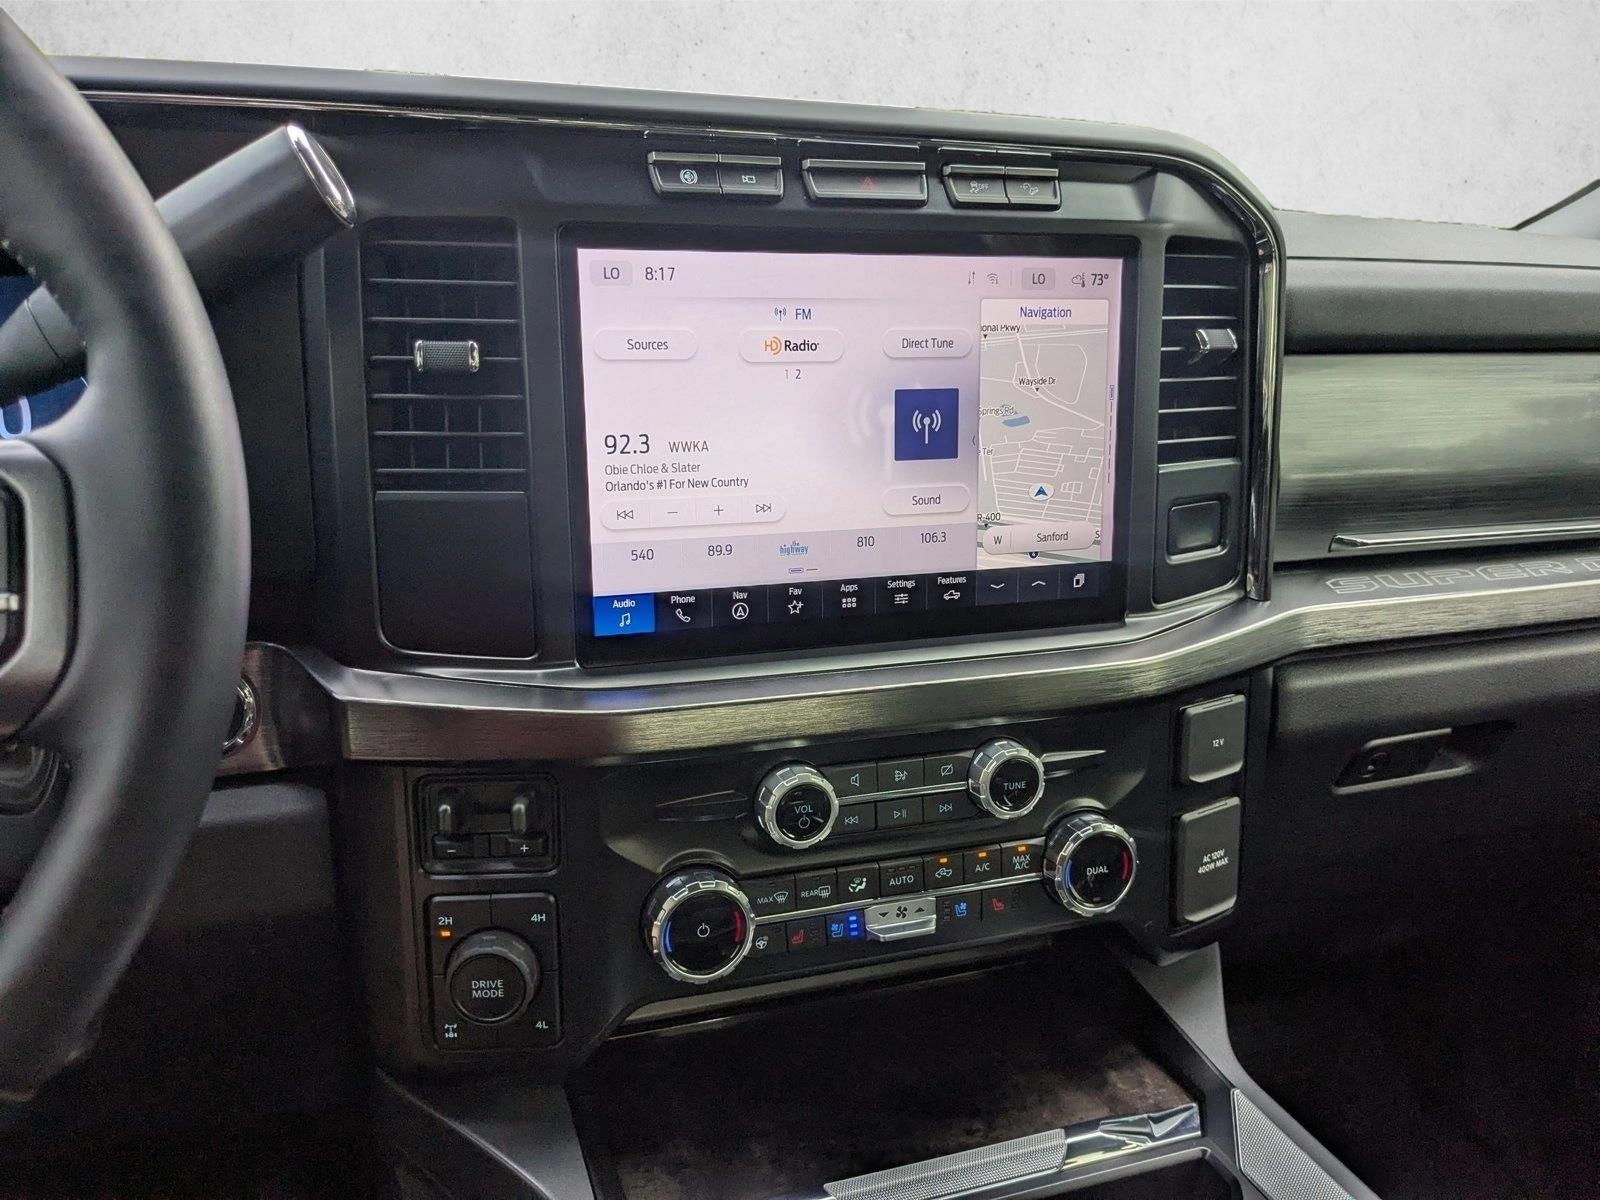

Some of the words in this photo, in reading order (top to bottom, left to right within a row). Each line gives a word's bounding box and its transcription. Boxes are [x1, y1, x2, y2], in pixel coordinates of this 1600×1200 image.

[603, 267, 620, 279] LO
[645, 267, 675, 281] 8:17
[1032, 273, 1046, 285] LO
[1091, 274, 1109, 286] 73°
[795, 308, 812, 320] FM
[1020, 306, 1072, 319] Navigation
[1001, 324, 1021, 333] Pkwy
[627, 338, 669, 351] Sources
[902, 337, 928, 349] Direct
[931, 337, 954, 349] Tune
[795, 369, 801, 380] 2
[1018, 377, 1047, 386] Wayside
[1048, 377, 1057, 385] Dr
[604, 434, 651, 455] 92.3
[668, 440, 709, 453] WWKA
[605, 464, 628, 475] Obie
[630, 463, 659, 475] Chloe
[661, 463, 669, 473] &
[671, 462, 701, 473] Slater
[605, 481, 654, 492] Orlando's
[656, 479, 667, 490] #1
[669, 479, 685, 490] For
[687, 478, 709, 489] New
[711, 476, 749, 490] Country
[912, 494, 941, 506] Sound
[857, 536, 875, 547] 810
[920, 532, 947, 545] 106.3
[993, 536, 1002, 545] W
[1037, 531, 1069, 543] Sanford
[631, 548, 654, 561] 540
[707, 544, 733, 557] 89.9
[780, 544, 808, 556] highway
[937, 576, 967, 585] Features
[1325, 559, 1574, 595] SUPER
[840, 583, 858, 594] Apps
[887, 579, 916, 590] Settings
[732, 591, 748, 599] Nav
[789, 588, 802, 596] Fav
[612, 599, 636, 608] Audio
[671, 595, 695, 604] Phone
[1003, 780, 1027, 790] TUNE
[795, 805, 814, 814] VOL
[1012, 854, 1030, 863] MAX
[1203, 854, 1211, 863] AC
[975, 862, 990, 872] A/C
[1014, 861, 1029, 870] A/C
[1198, 862, 1215, 873] 400W
[1216, 856, 1228, 868] MAX
[1087, 865, 1108, 876] DUAL
[889, 876, 914, 886] AUTO
[801, 890, 818, 898] REAR
[438, 916, 453, 926] 2H
[530, 914, 546, 922] 4H
[471, 980, 503, 989] DRIVE
[472, 989, 504, 998] MODE
[536, 1020, 548, 1029] 4L
